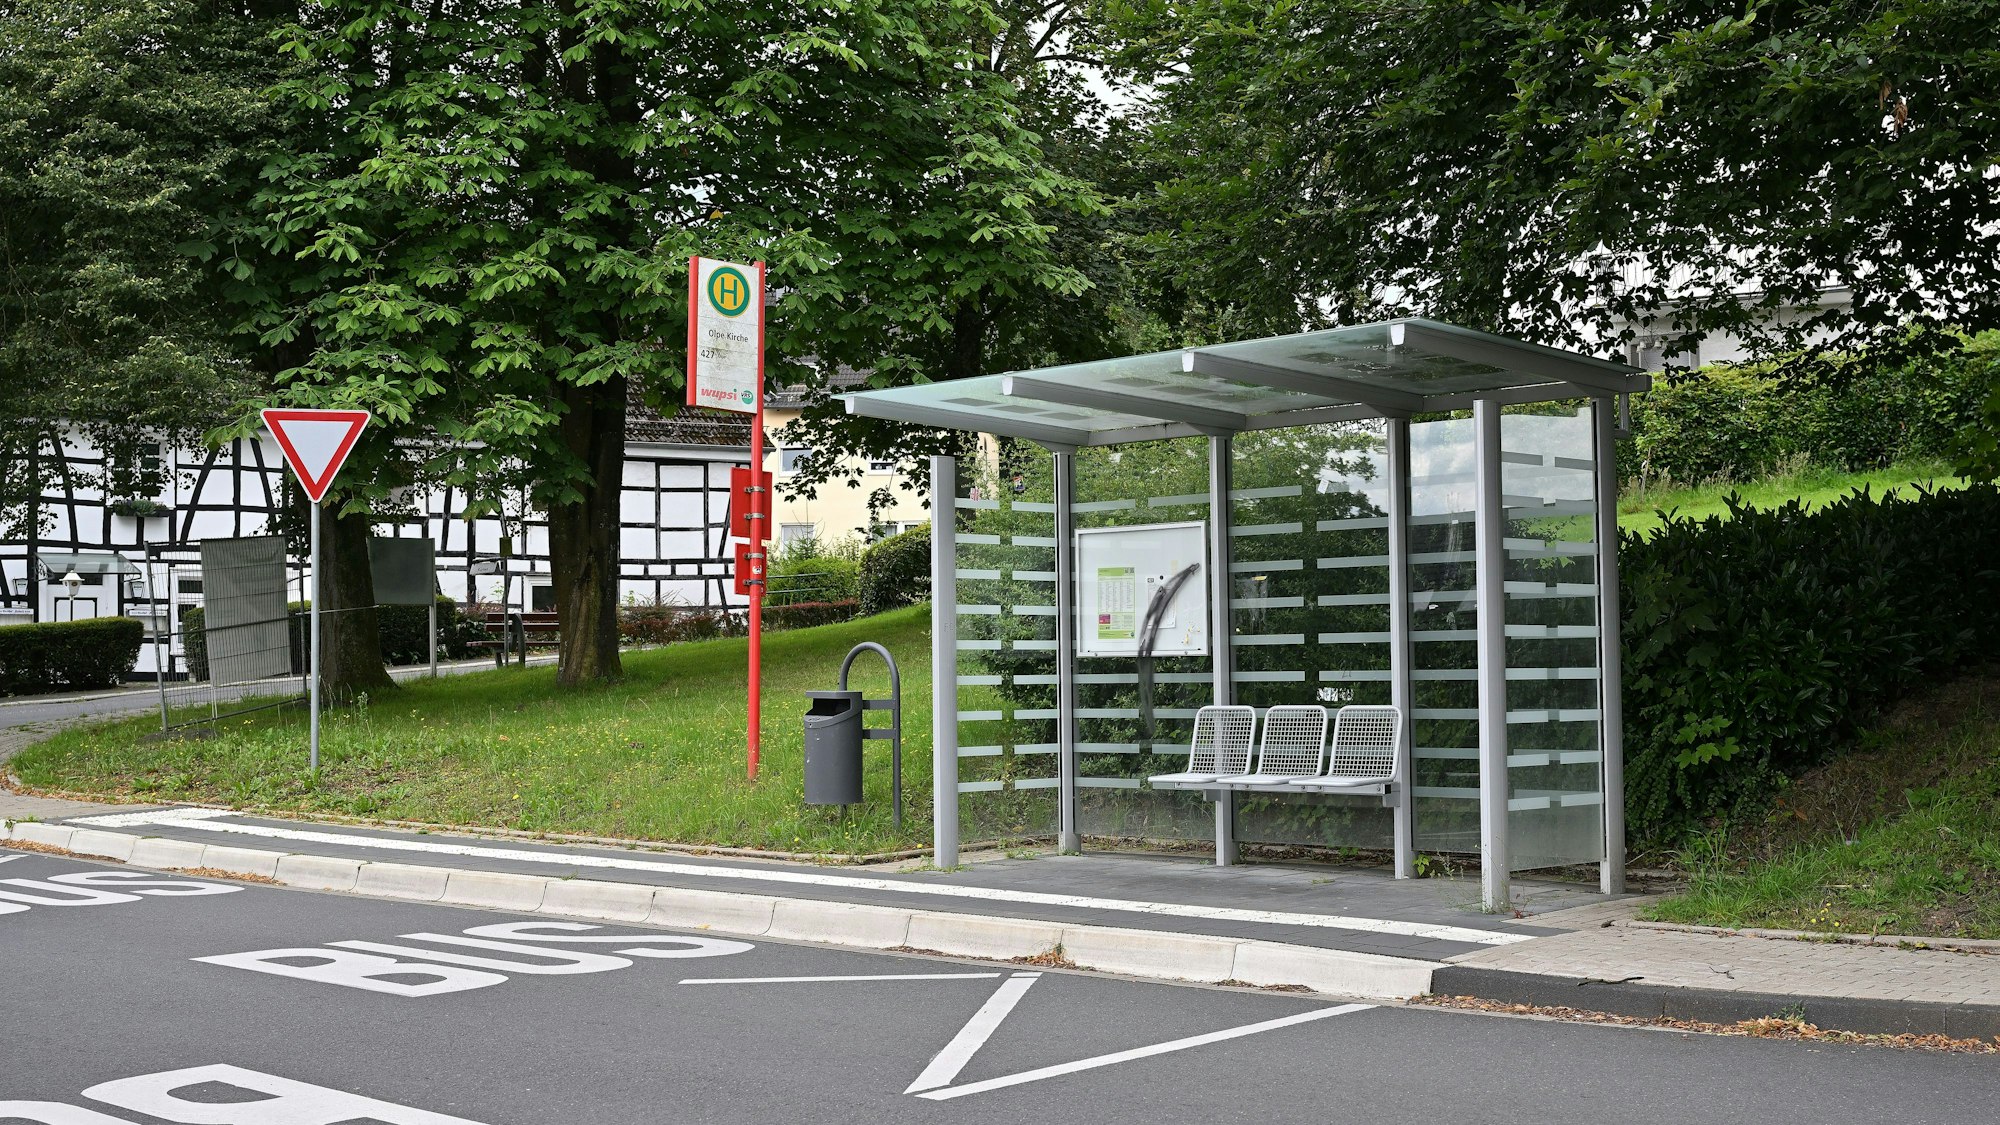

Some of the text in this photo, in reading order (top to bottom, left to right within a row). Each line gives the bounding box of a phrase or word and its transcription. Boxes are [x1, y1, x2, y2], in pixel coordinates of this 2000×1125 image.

[720, 277, 738, 306] H
[708, 329, 749, 342] Olpe Kirche
[700, 349, 715, 359] 427
[700, 388, 737, 401] wupsi
[0, 871, 246, 914] US
[189, 921, 756, 997] BUS
